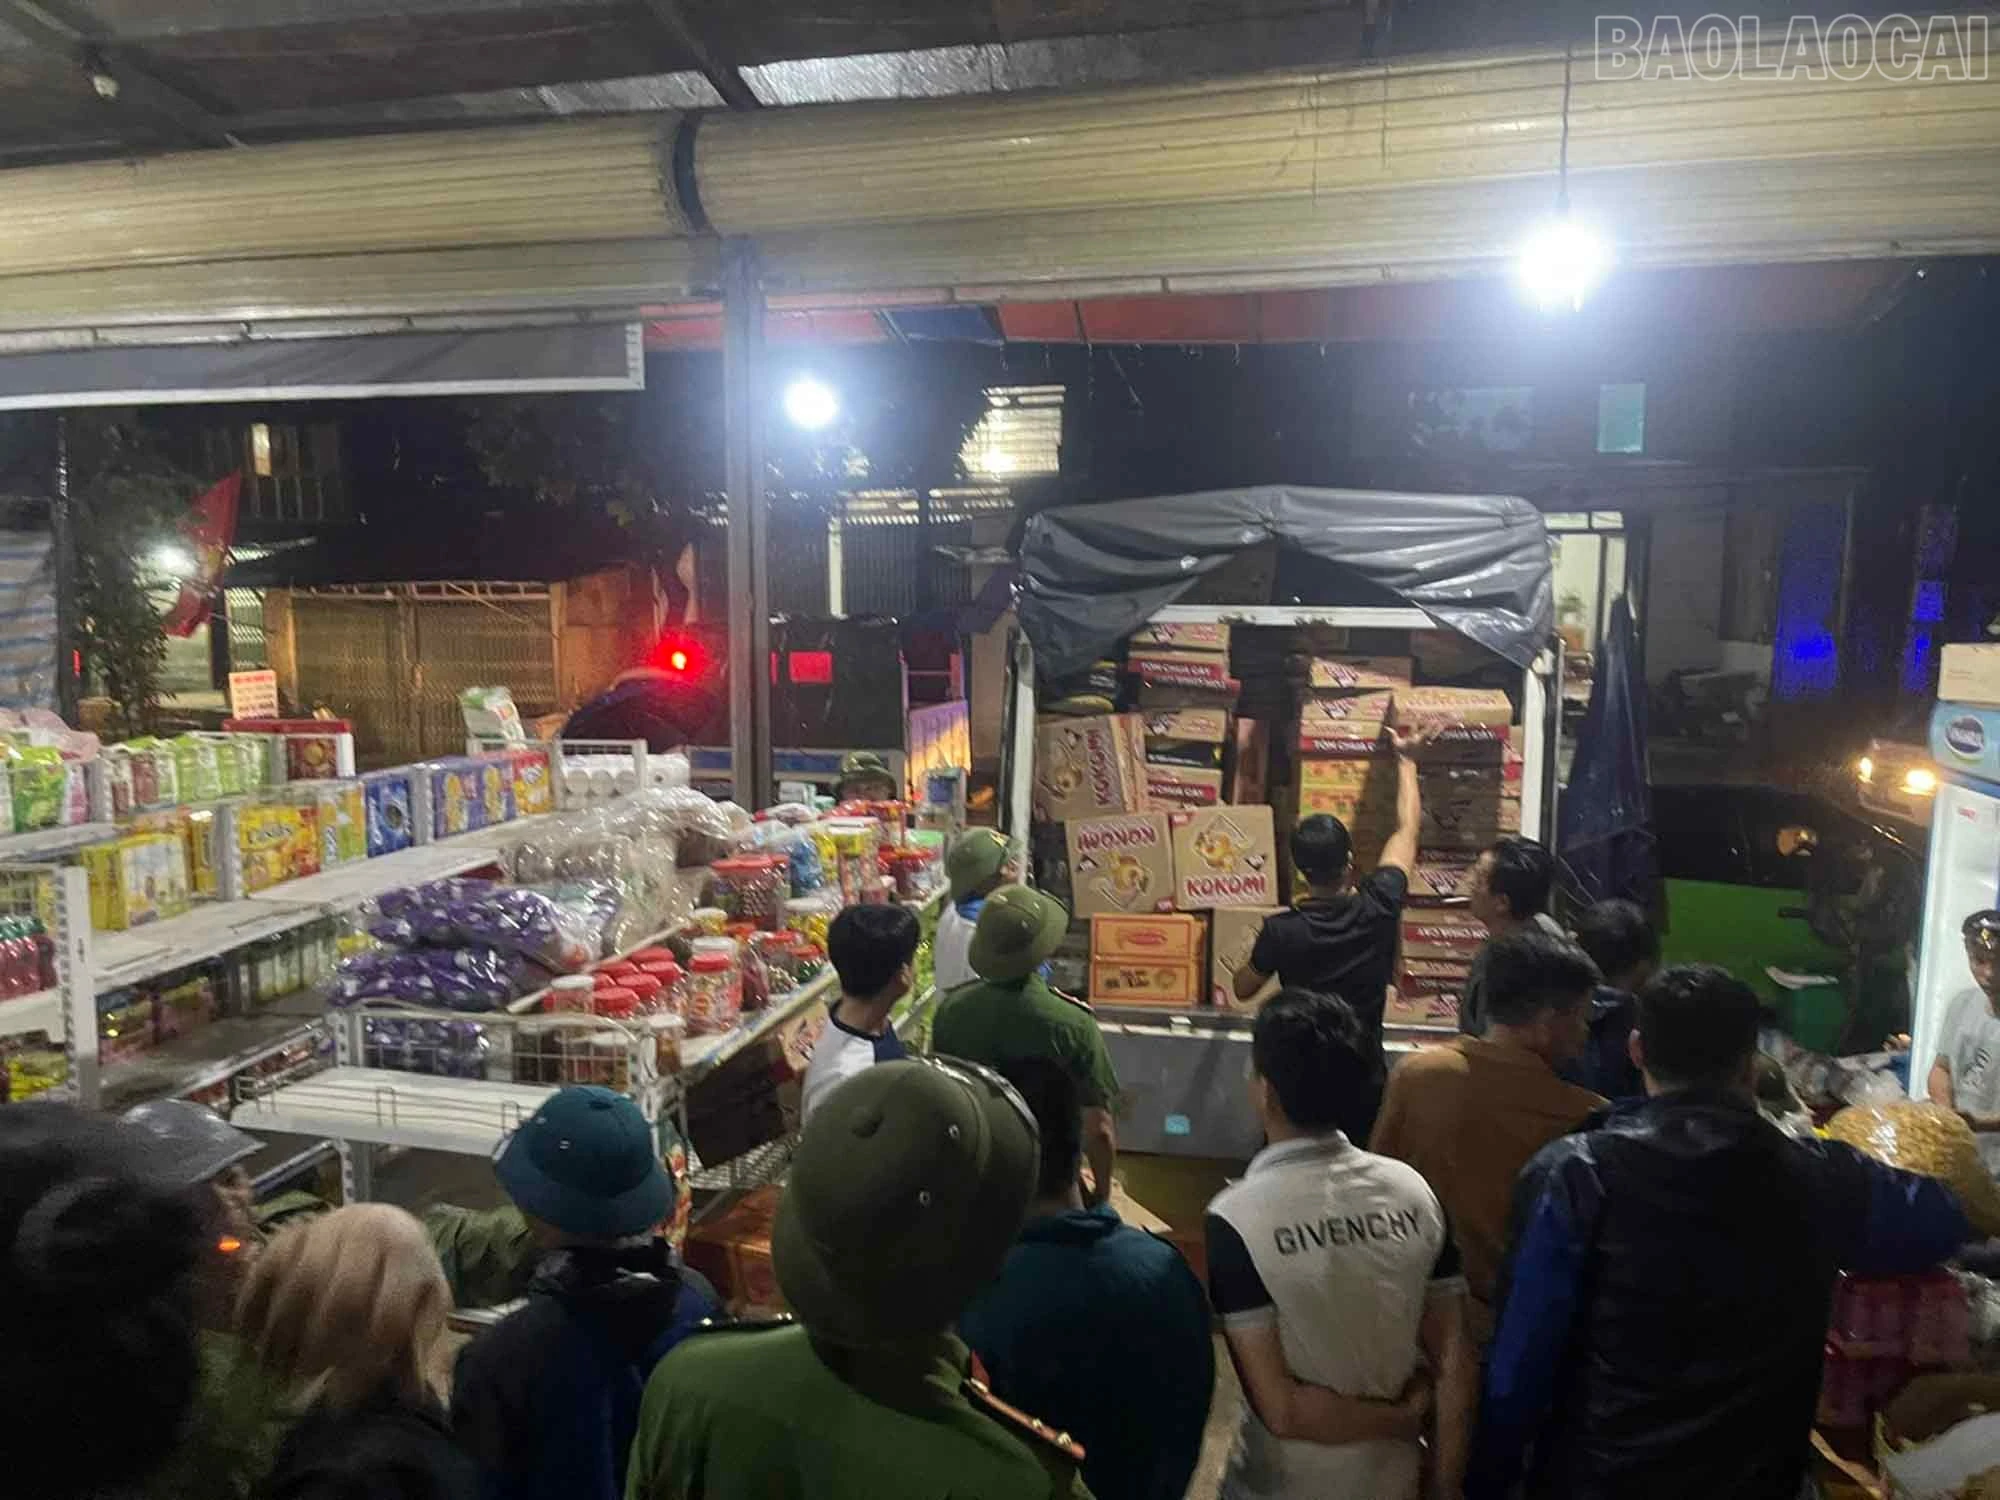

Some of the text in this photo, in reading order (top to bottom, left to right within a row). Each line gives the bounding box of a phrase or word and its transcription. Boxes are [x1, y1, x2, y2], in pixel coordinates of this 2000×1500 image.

[1077, 826, 1156, 849] KOKOMI
[1186, 876, 1266, 896] KOKOMI
[1273, 1207, 1420, 1256] GIVENCHY
